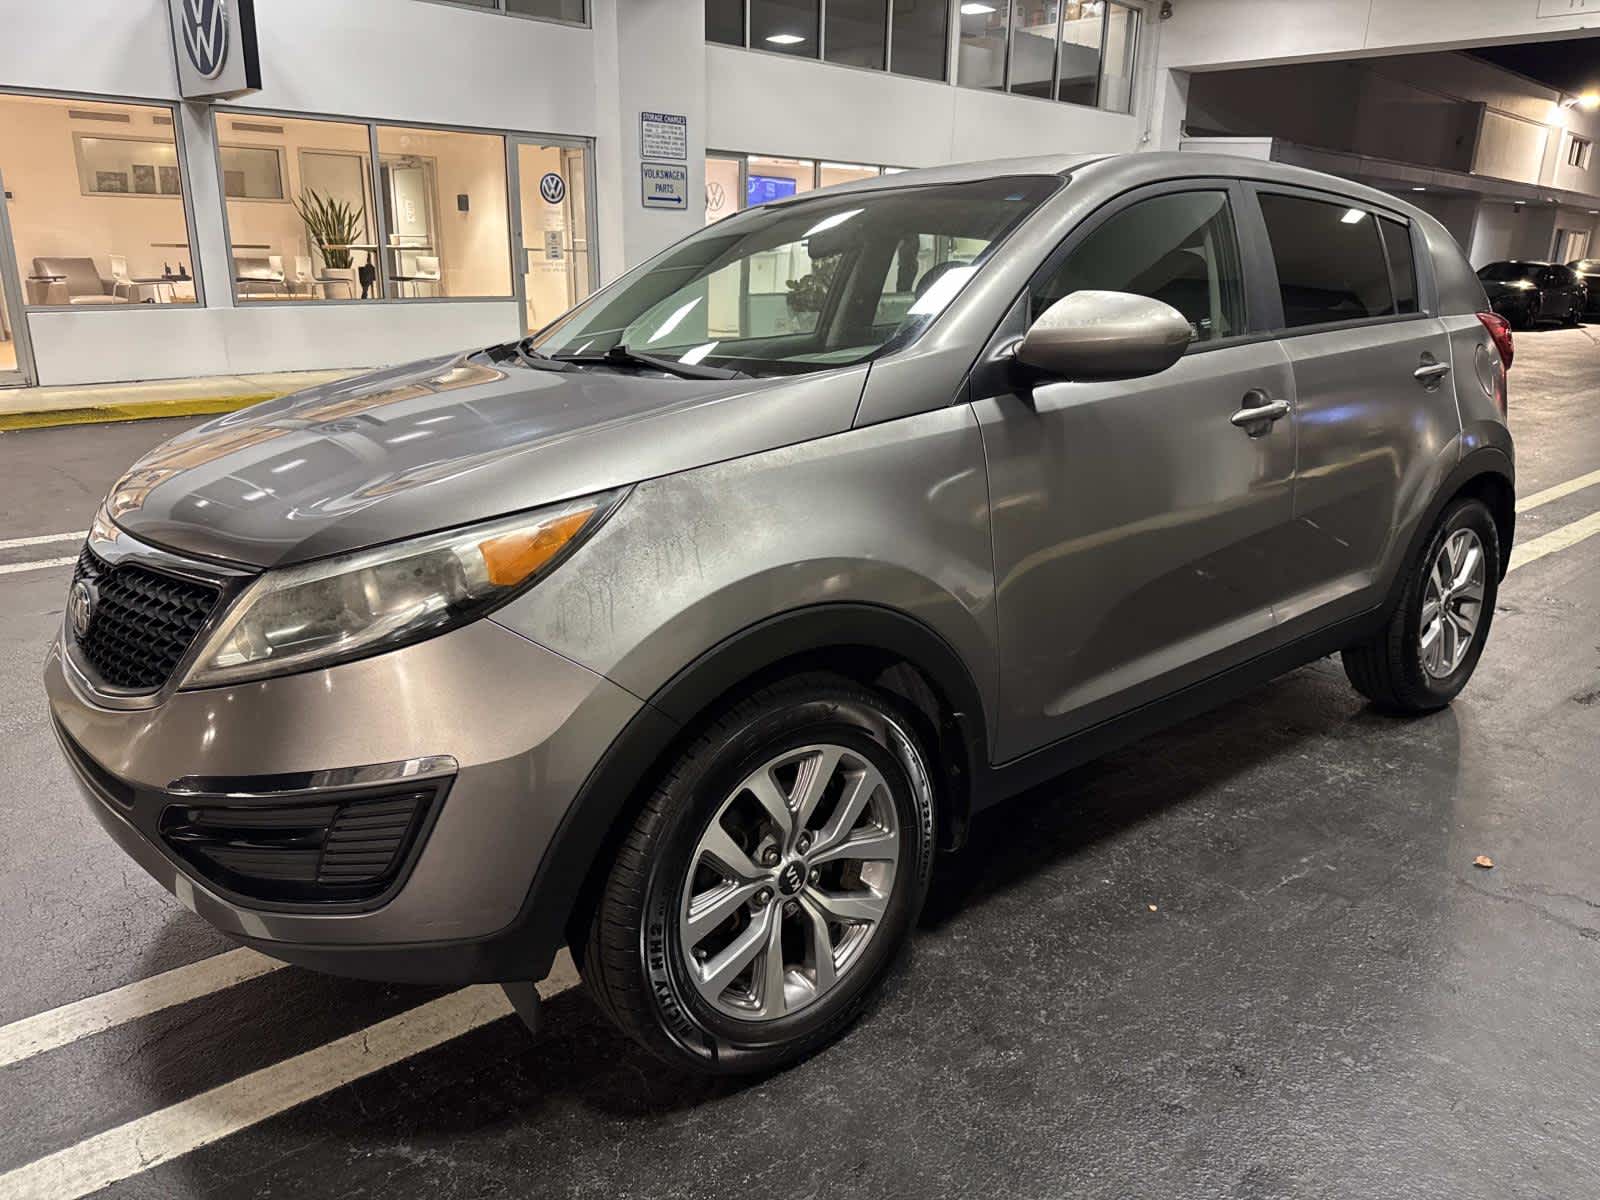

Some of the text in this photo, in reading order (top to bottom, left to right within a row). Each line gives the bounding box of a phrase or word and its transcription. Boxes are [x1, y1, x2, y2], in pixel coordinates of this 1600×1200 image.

[643, 112, 663, 121] STORAGE
[644, 168, 685, 180] VOLKSWAGEN
[541, 174, 564, 202] VW
[655, 183, 674, 193] PARTS
[706, 183, 725, 211] VW
[786, 864, 801, 892] KIA
